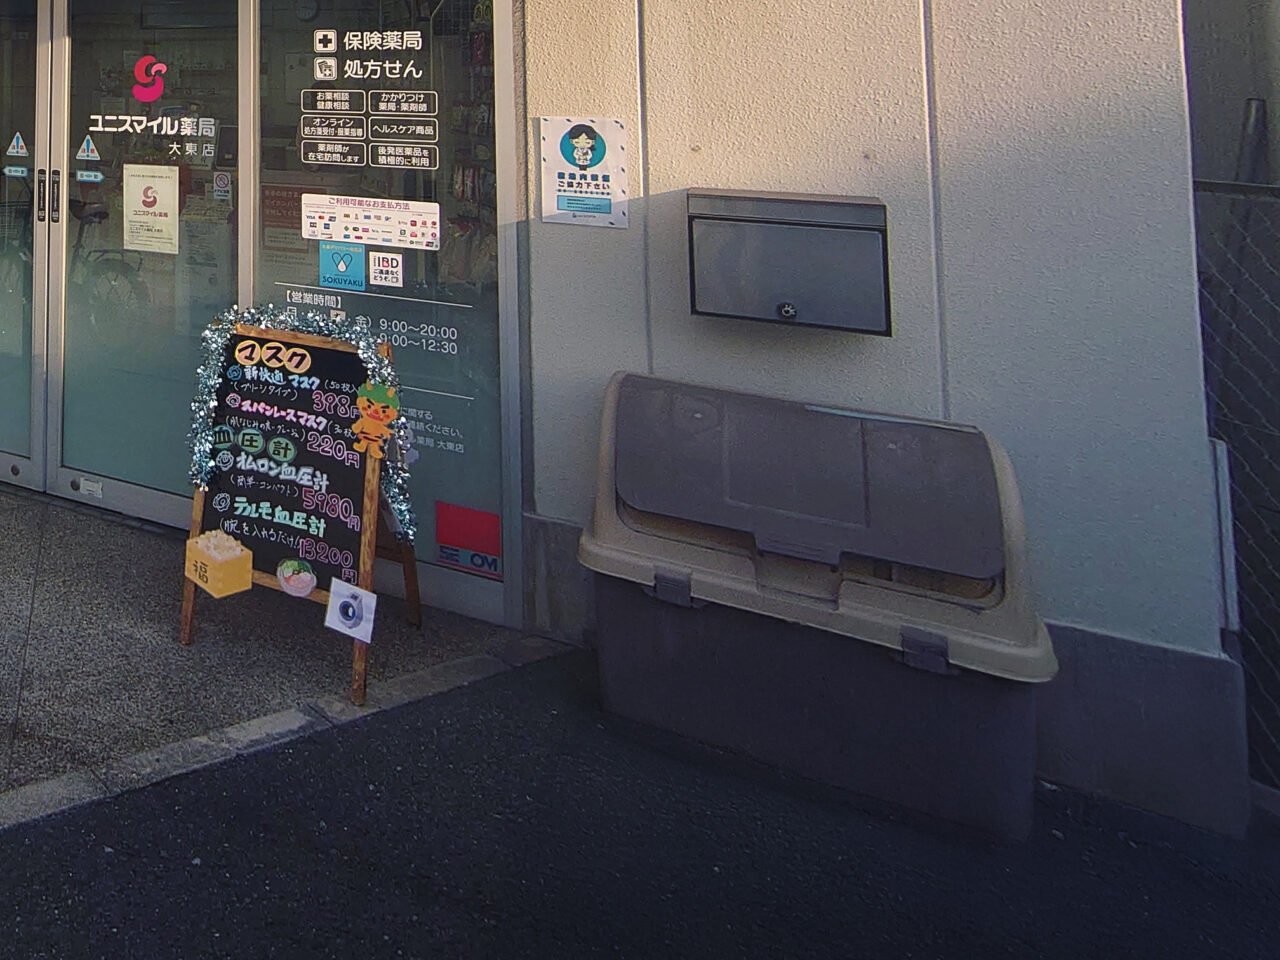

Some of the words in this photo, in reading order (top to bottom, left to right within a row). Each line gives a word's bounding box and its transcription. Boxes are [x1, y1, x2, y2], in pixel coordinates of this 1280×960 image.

[343, 30, 423, 51] 保険薬局
[343, 59, 423, 79] 処方せん
[316, 92, 350, 101] お薬相談
[381, 93, 425, 102] かかりつけ
[316, 101, 350, 110] 健康相談
[378, 102, 428, 112] 薬局・薬剤師
[89, 115, 215, 137] ユニスマイル薬局
[312, 117, 354, 127] オンライン
[372, 124, 434, 135] ヘルスケア商品
[168, 141, 215, 157] 大東店
[317, 143, 350, 153] 薬剤師が
[378, 146, 430, 157] 後発医薬品を
[308, 152, 360, 163] 在宅訪問します
[378, 155, 430, 167] 積極的に利用
[557, 180, 610, 190] ご協力下さい
[328, 197, 411, 210] ご利用可能なお支払方法
[322, 275, 364, 287] SOKUYAKU
[285, 289, 342, 309] 【営業時間】
[237, 343, 308, 369] マスク
[288, 374, 321, 390] マスク
[241, 400, 328, 431] スパンレースマスク
[327, 421, 358, 439] (30枚
[214, 428, 294, 459] 血圧計
[307, 431, 360, 468] 220円
[436, 440, 465, 453] 大東店
[236, 452, 330, 493] オムロン血圧計
[302, 487, 361, 532] 5980円
[233, 496, 327, 538] テルモ血圧計
[192, 559, 209, 585] 福
